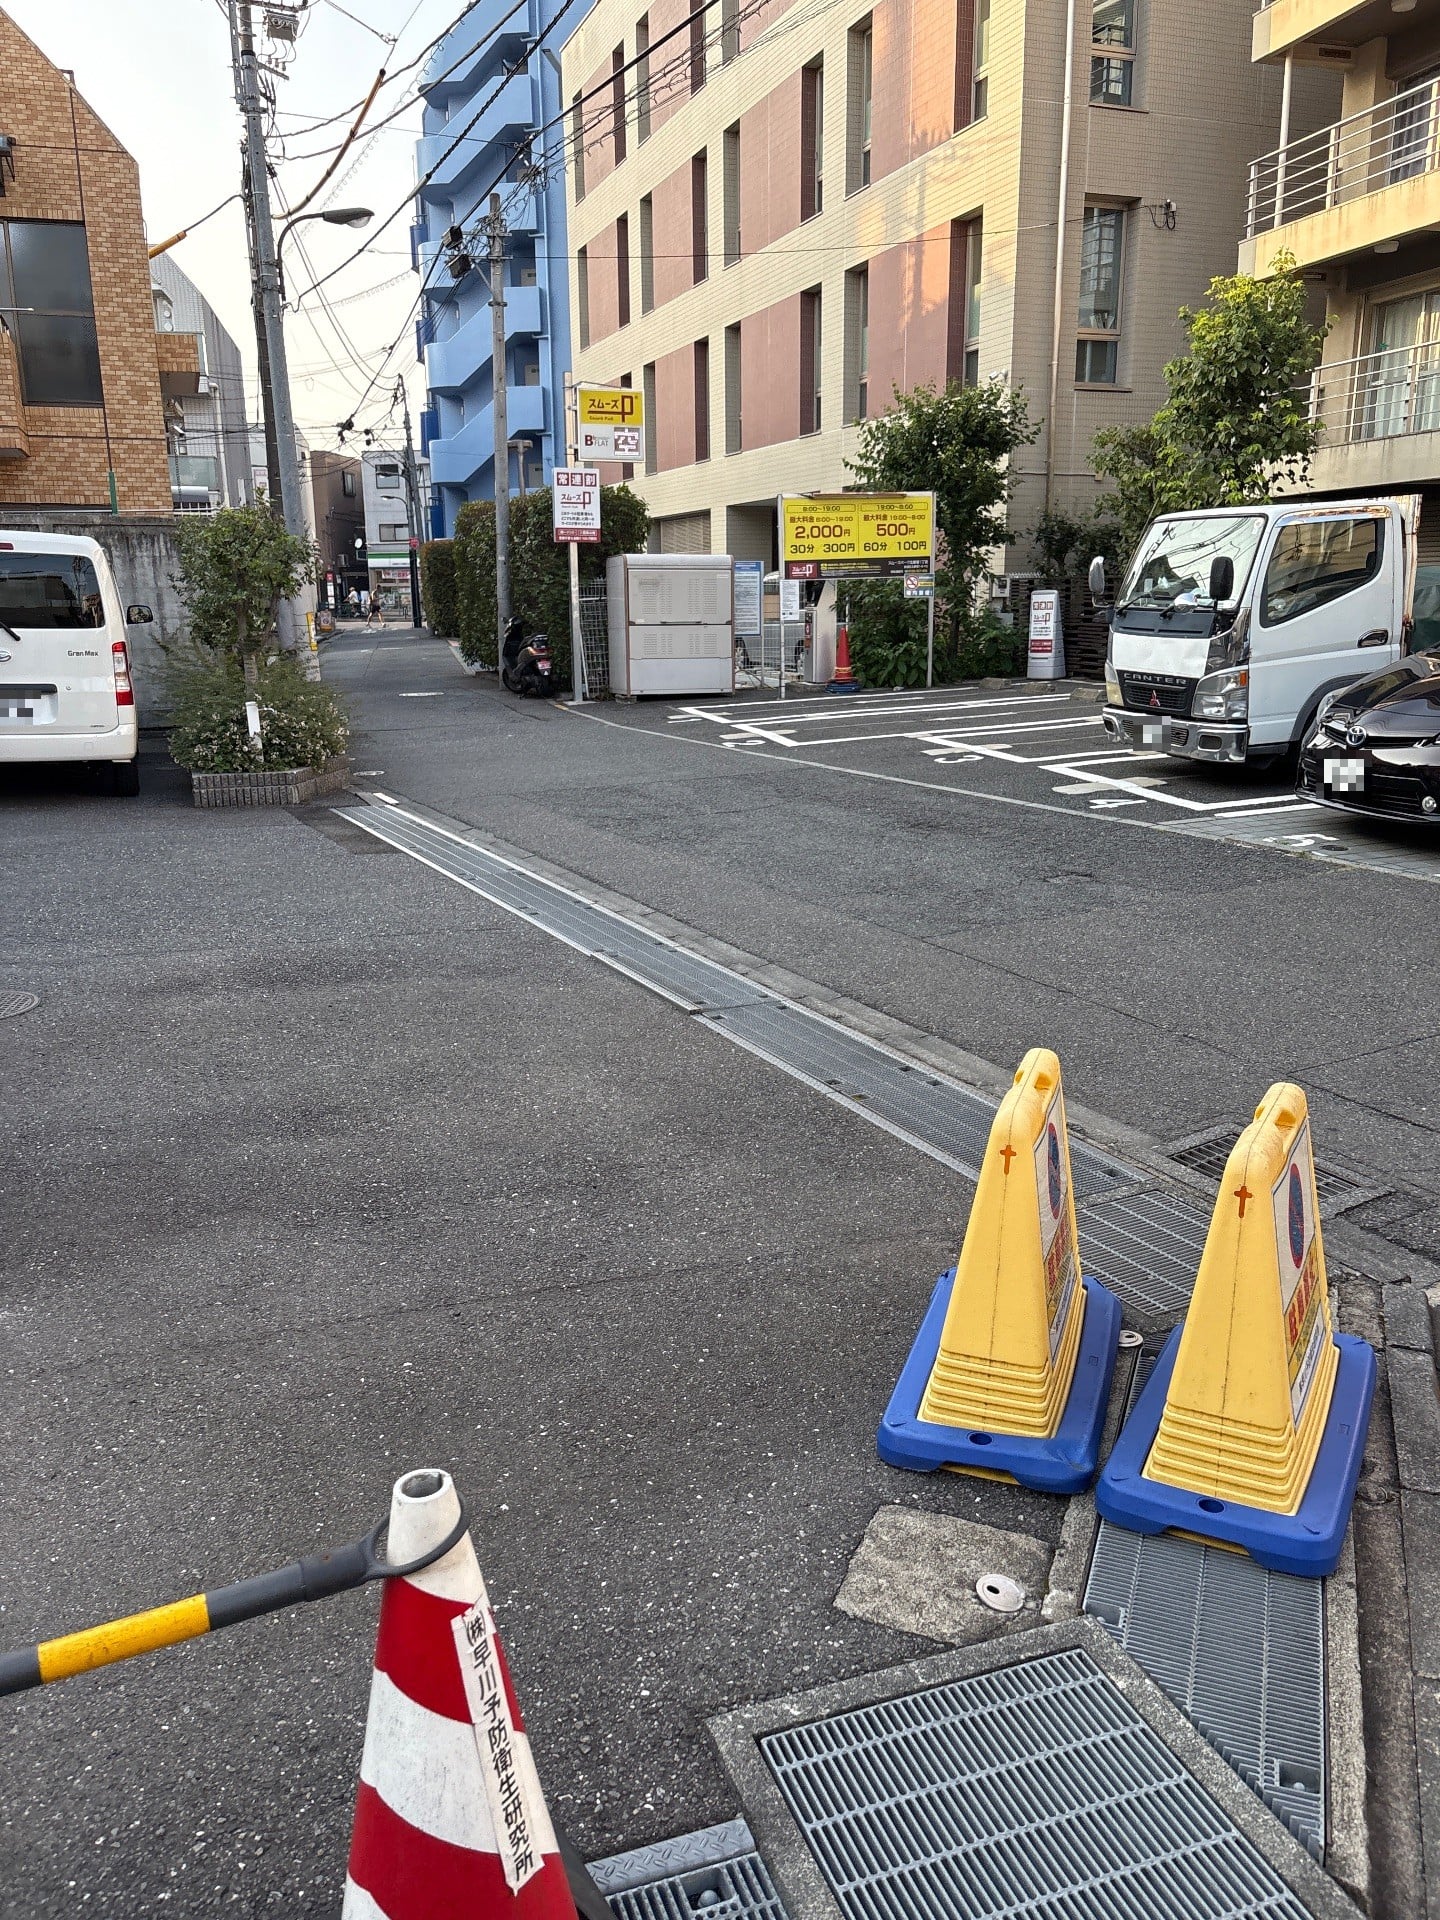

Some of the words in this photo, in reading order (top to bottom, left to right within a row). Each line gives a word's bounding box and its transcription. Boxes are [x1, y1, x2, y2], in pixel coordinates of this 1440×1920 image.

[790, 543, 815, 554] 30分
[823, 542, 856, 553] 300円
[863, 542, 888, 552] 60分
[896, 541, 927, 551] 100円
[1123, 672, 1187, 685] CANTER
[721, 739, 767, 748] 2
[933, 754, 985, 764] 3
[1089, 798, 1148, 809] 4
